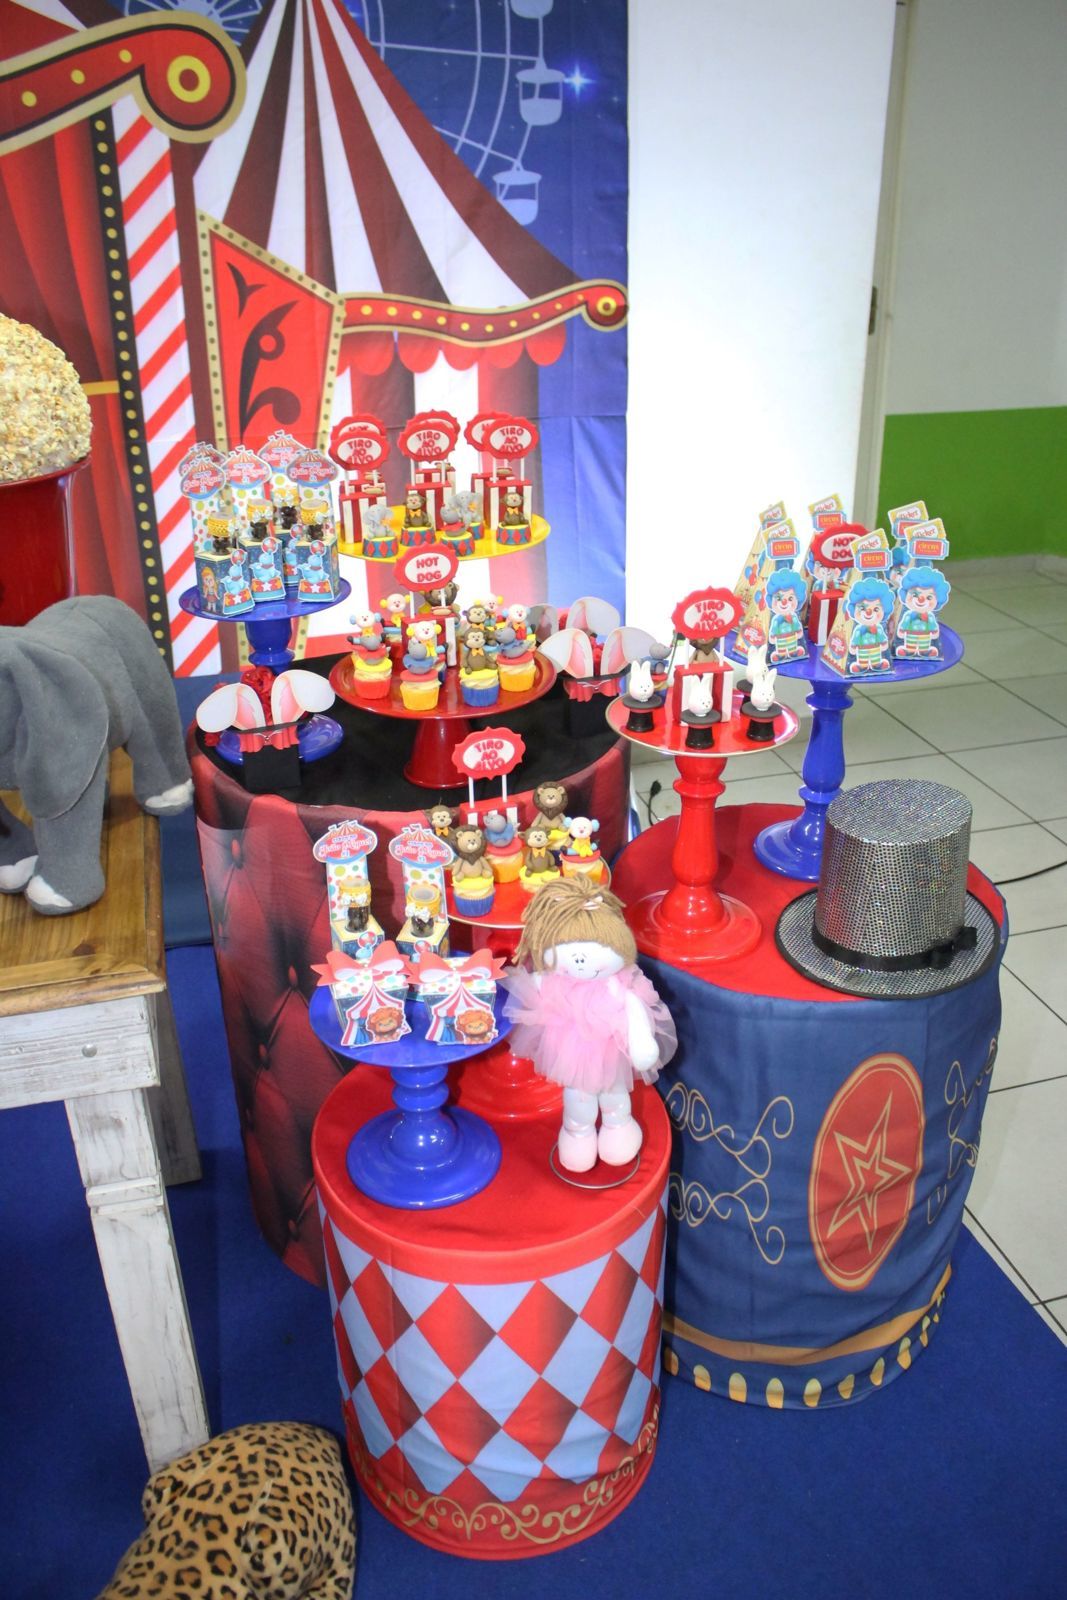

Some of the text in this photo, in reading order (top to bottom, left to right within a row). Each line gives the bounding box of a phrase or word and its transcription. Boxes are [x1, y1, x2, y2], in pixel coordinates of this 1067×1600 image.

[416, 431, 441, 441] TIRO
[499, 426, 524, 437] TIRO
[347, 438, 373, 449] TIRO
[421, 440, 435, 449] AO
[504, 436, 518, 445] AO
[352, 447, 367, 457] AO
[416, 556, 439, 569] HOT
[417, 570, 442, 583] DOG
[695, 600, 725, 614] TIRO
[700, 610, 718, 622] AO
[474, 739, 505, 753] TIRO
[481, 749, 498, 761] AO
